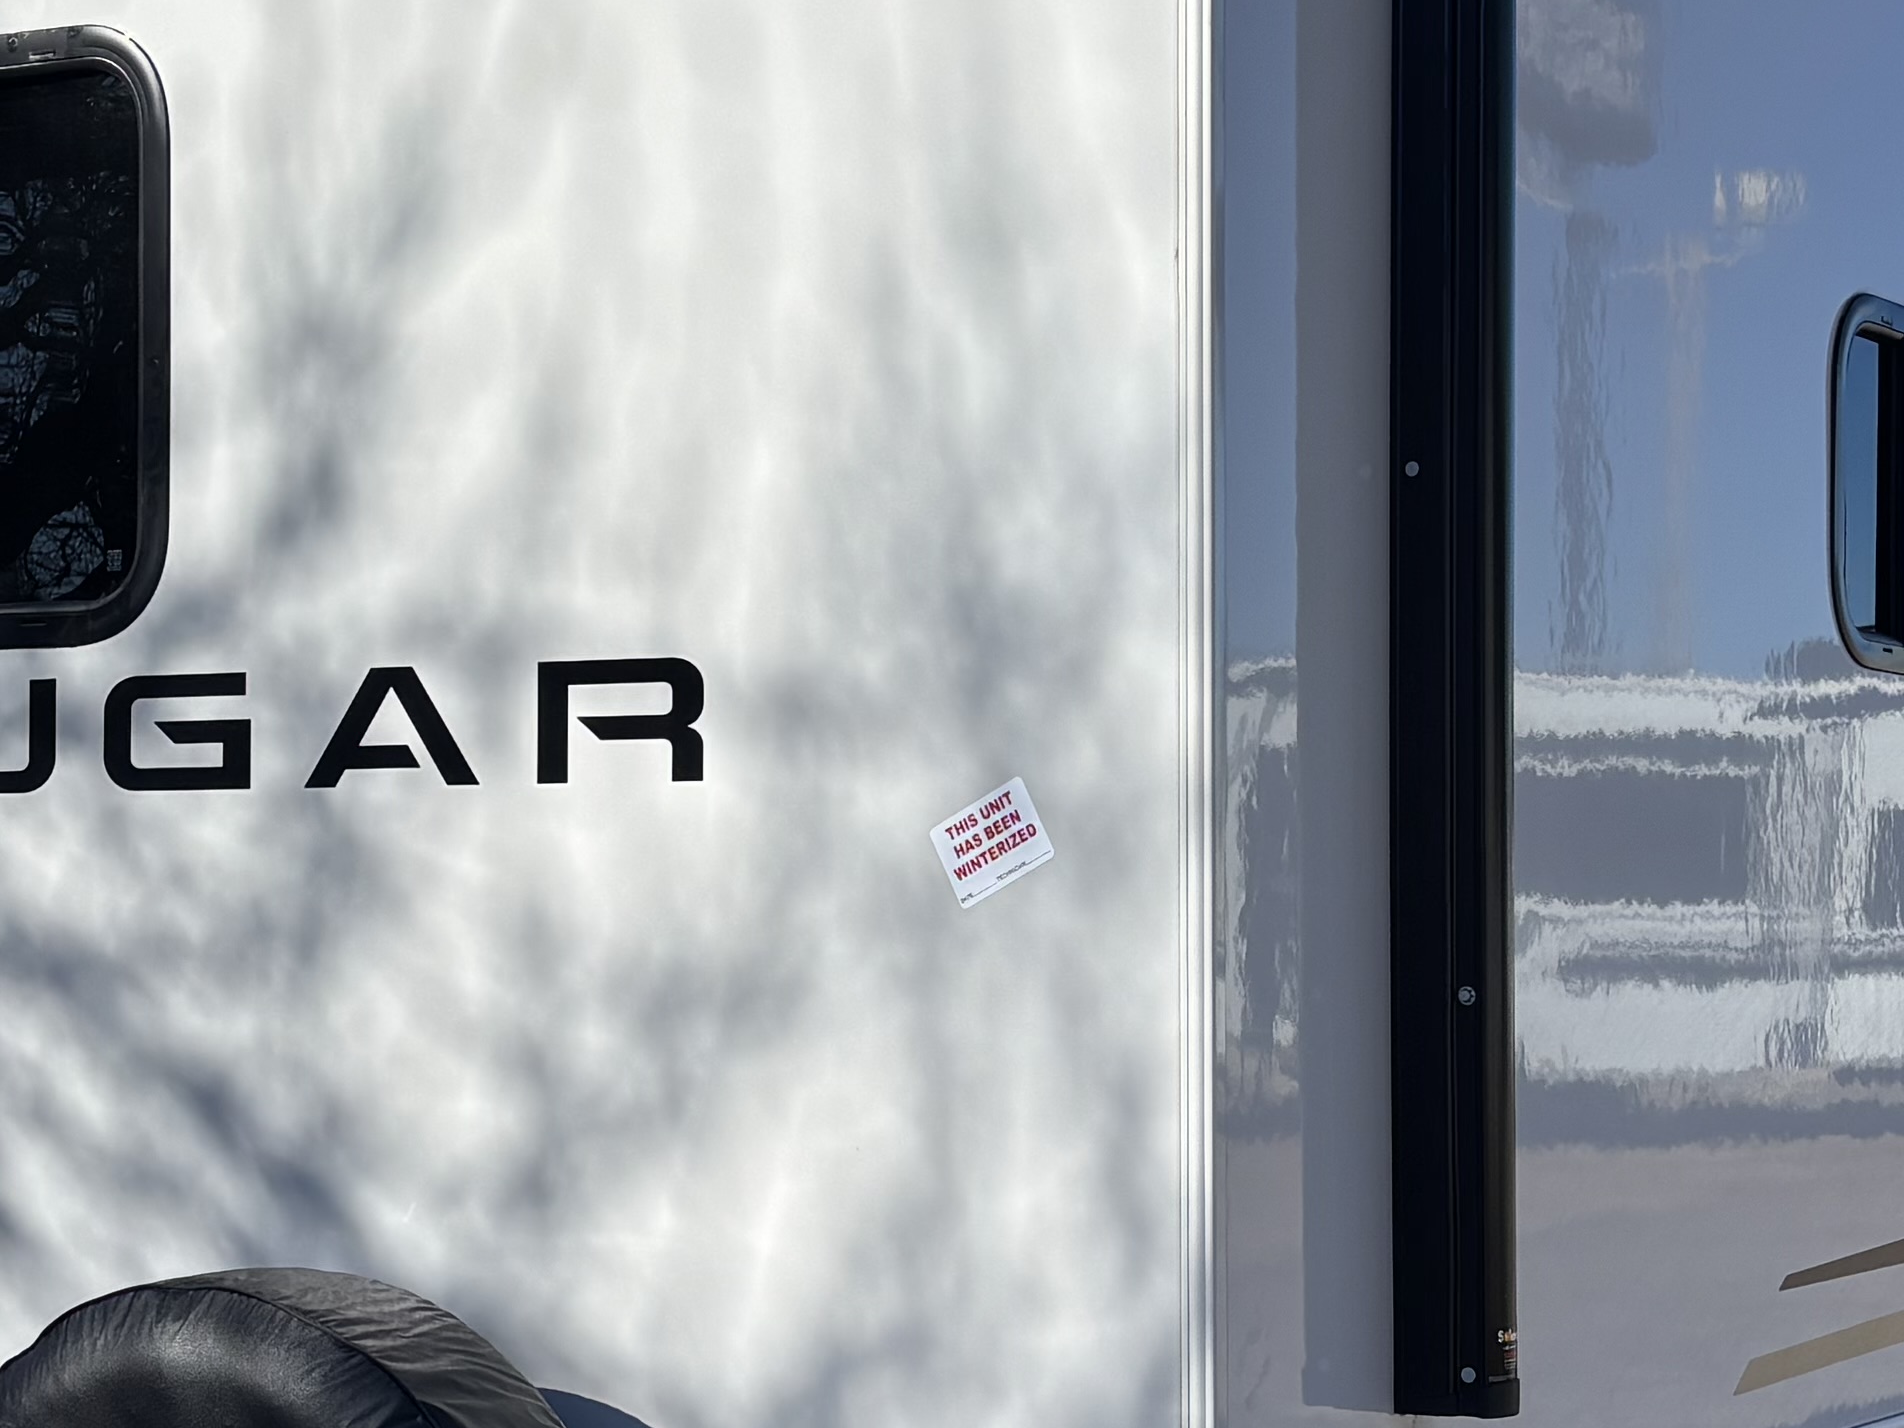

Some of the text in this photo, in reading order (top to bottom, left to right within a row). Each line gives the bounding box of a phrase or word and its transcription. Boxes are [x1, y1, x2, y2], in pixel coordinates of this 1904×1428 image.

[945, 790, 1013, 841] THIS UNIT
[953, 809, 1022, 859] HAS BEEN
[953, 823, 1038, 881] WINTERIZED
